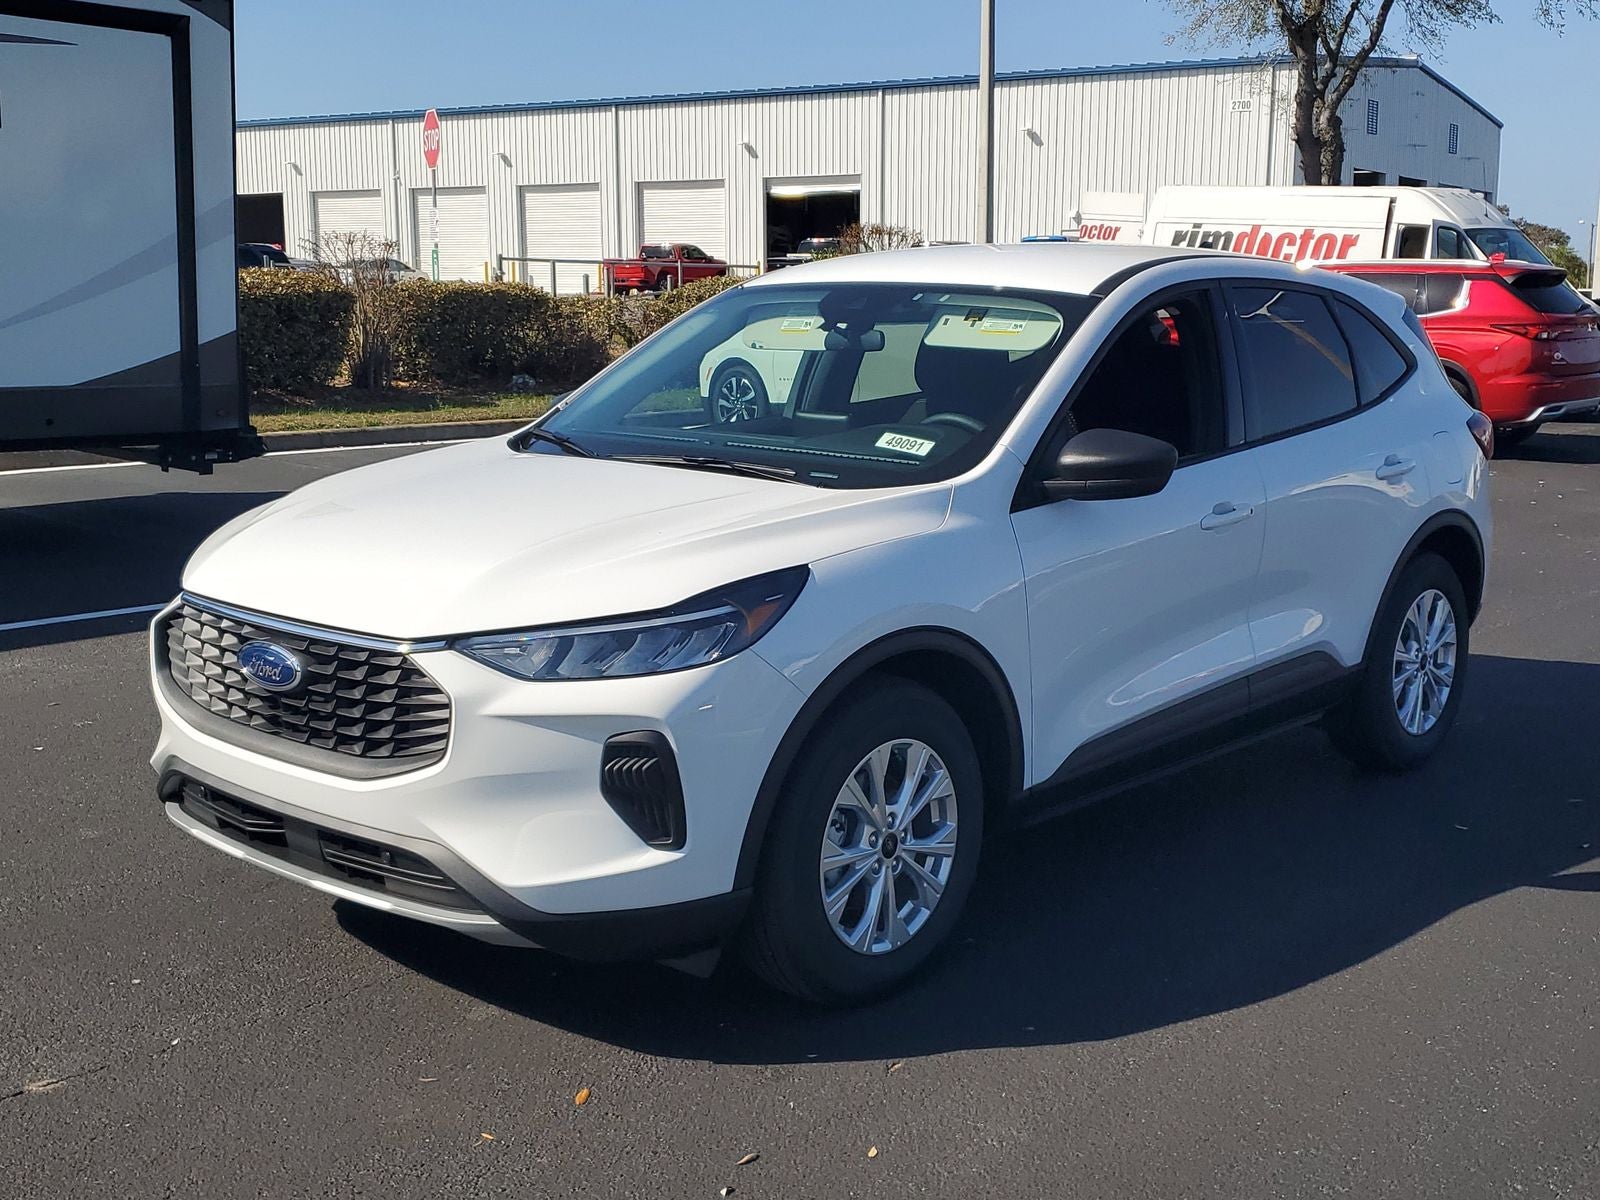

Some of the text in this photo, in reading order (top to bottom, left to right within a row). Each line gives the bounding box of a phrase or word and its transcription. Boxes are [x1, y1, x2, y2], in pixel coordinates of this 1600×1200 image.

[1231, 100, 1251, 110] 2700
[423, 129, 439, 152] STOP
[1170, 223, 1361, 262] rimdoctor
[885, 436, 925, 453] 49091
[247, 654, 284, 681] Ford
